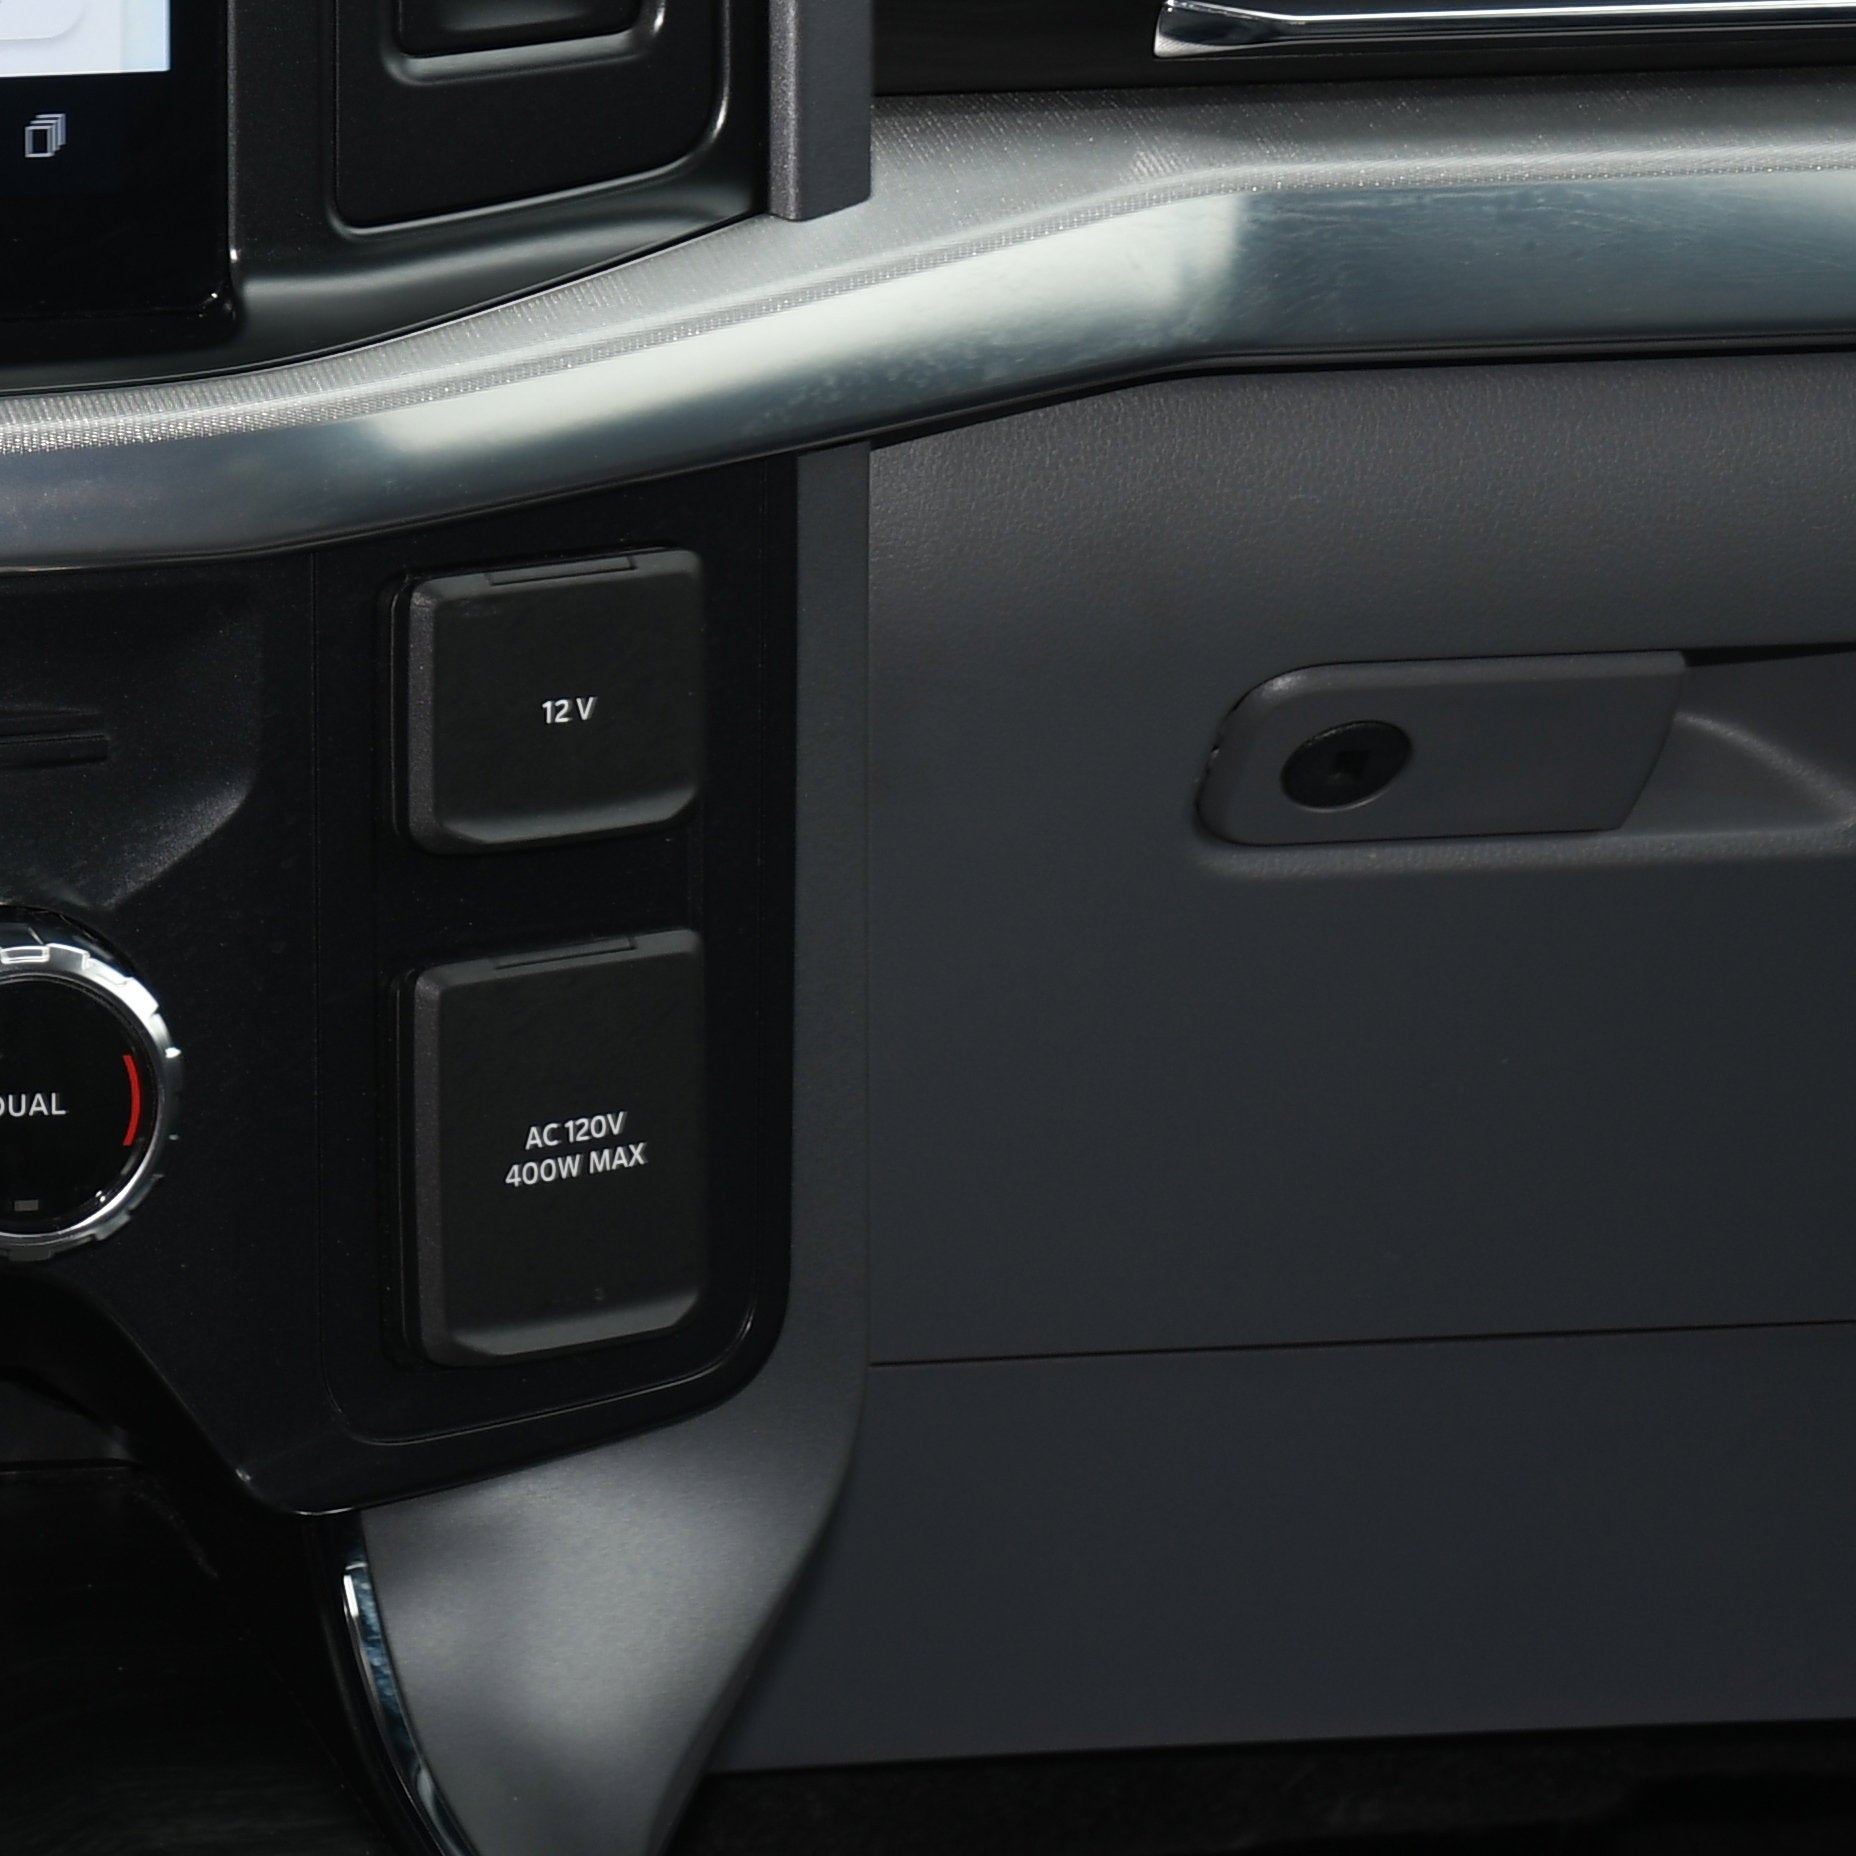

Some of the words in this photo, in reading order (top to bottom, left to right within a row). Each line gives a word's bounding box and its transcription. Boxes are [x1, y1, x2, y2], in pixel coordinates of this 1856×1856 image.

[542, 699, 570, 723] 12
[576, 696, 596, 721] V
[525, 1123, 561, 1148] AC
[565, 1112, 624, 1144] 120V
[505, 1155, 580, 1188] 400W
[588, 1143, 646, 1173] MAX
